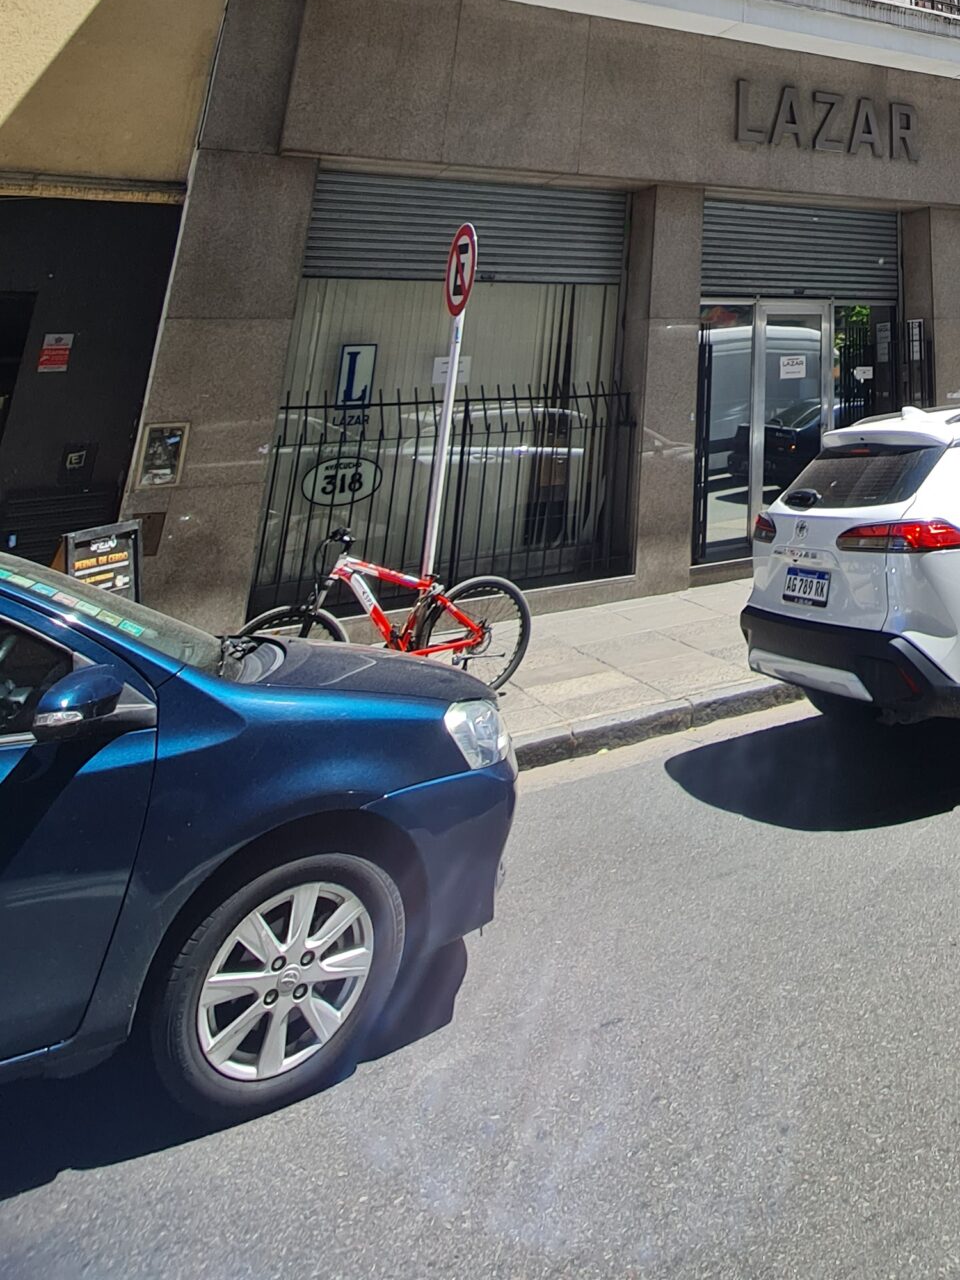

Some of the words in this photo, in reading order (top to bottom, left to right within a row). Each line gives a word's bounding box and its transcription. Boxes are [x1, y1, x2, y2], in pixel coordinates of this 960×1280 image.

[734, 78, 920, 163] LAZAR
[452, 242, 470, 297] E
[341, 351, 368, 403] L
[332, 414, 370, 427] LAZAR
[321, 472, 363, 495] 318
[786, 576, 798, 593] AG
[798, 578, 814, 596] 789
[814, 580, 826, 598] RK
